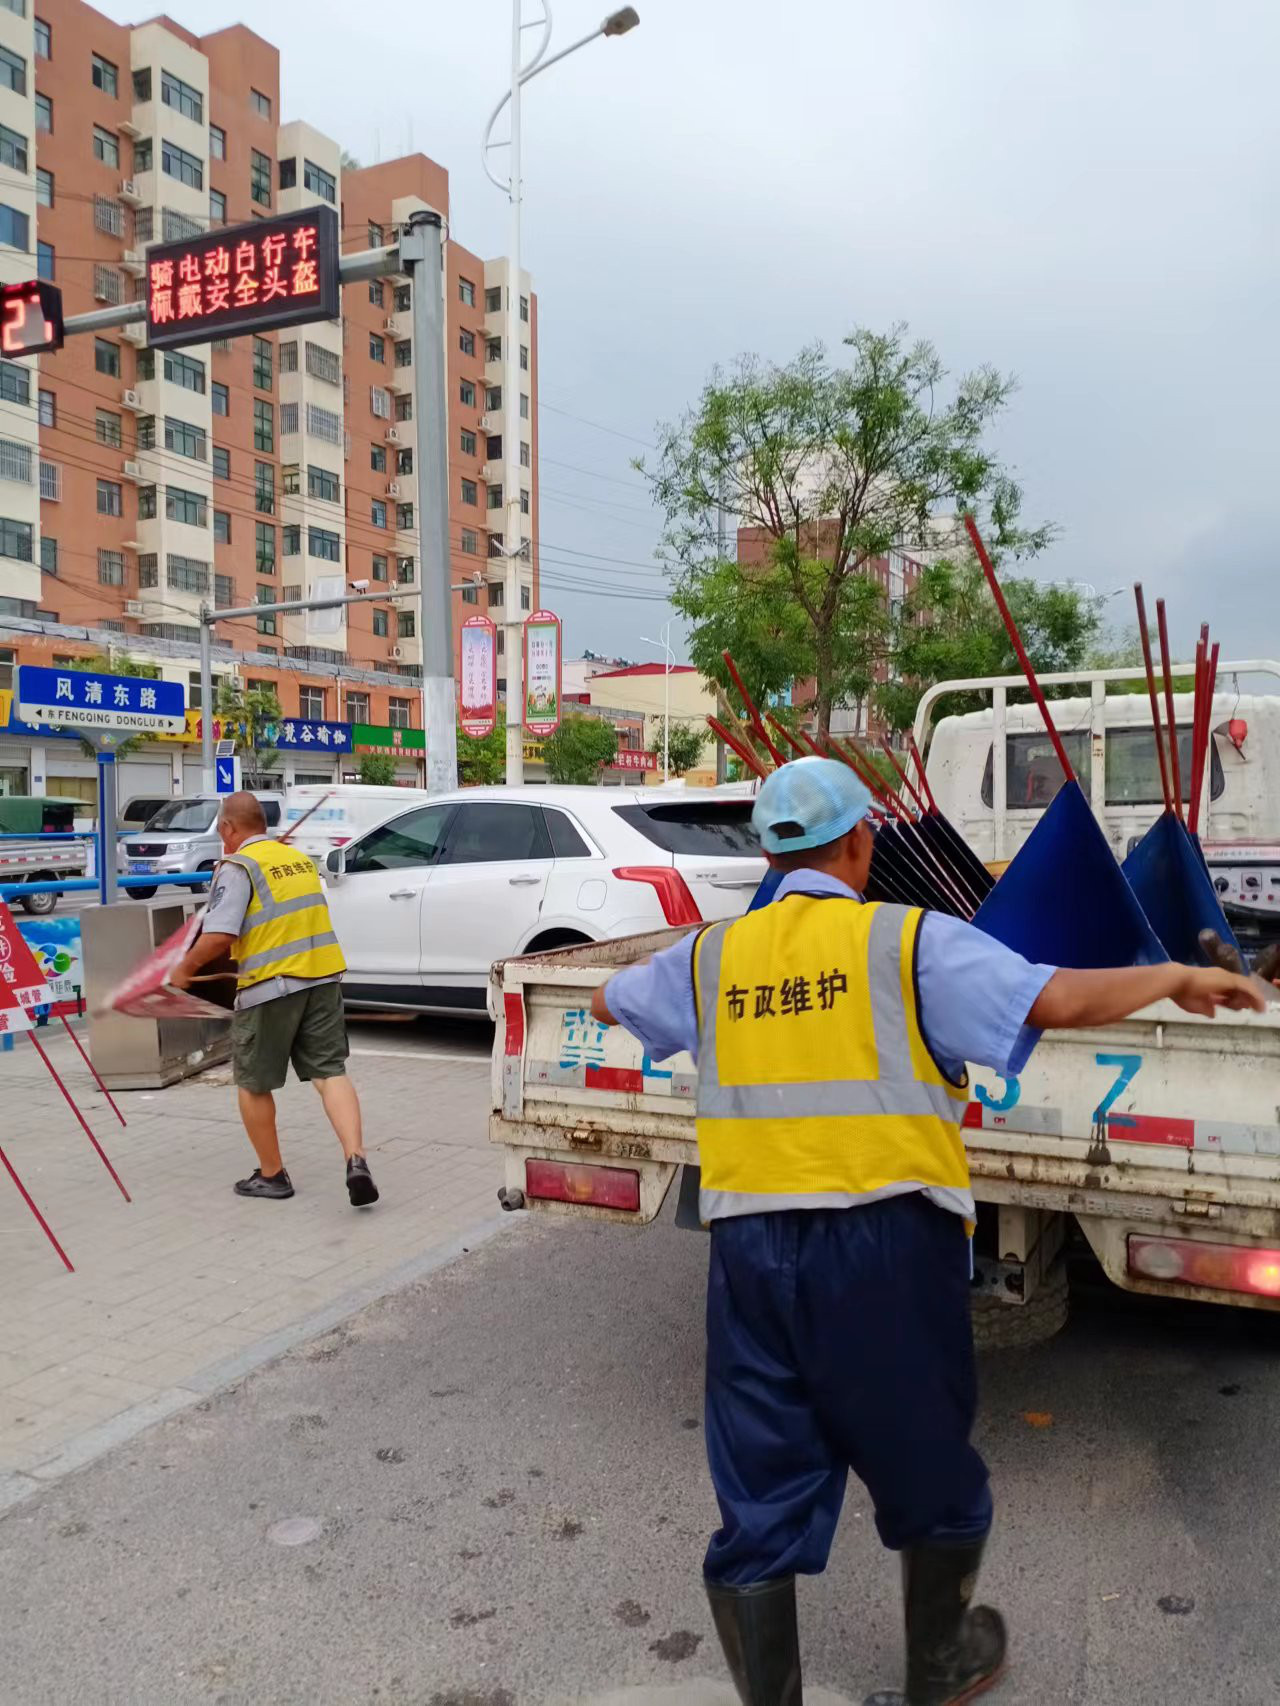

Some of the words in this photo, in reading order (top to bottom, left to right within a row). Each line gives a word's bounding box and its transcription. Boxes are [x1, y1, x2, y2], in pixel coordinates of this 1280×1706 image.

[150, 227, 317, 290] 骑电动自行车
[150, 260, 319, 324] 佩戴安全头盔
[56, 677, 157, 709] 风清东路
[58, 710, 111, 724] FENGQING
[117, 715, 156, 727] DONGLU
[284, 722, 347, 745] 梵谷瑜伽
[20, 988, 42, 1005] 城管
[725, 967, 850, 1023] 市政维护
